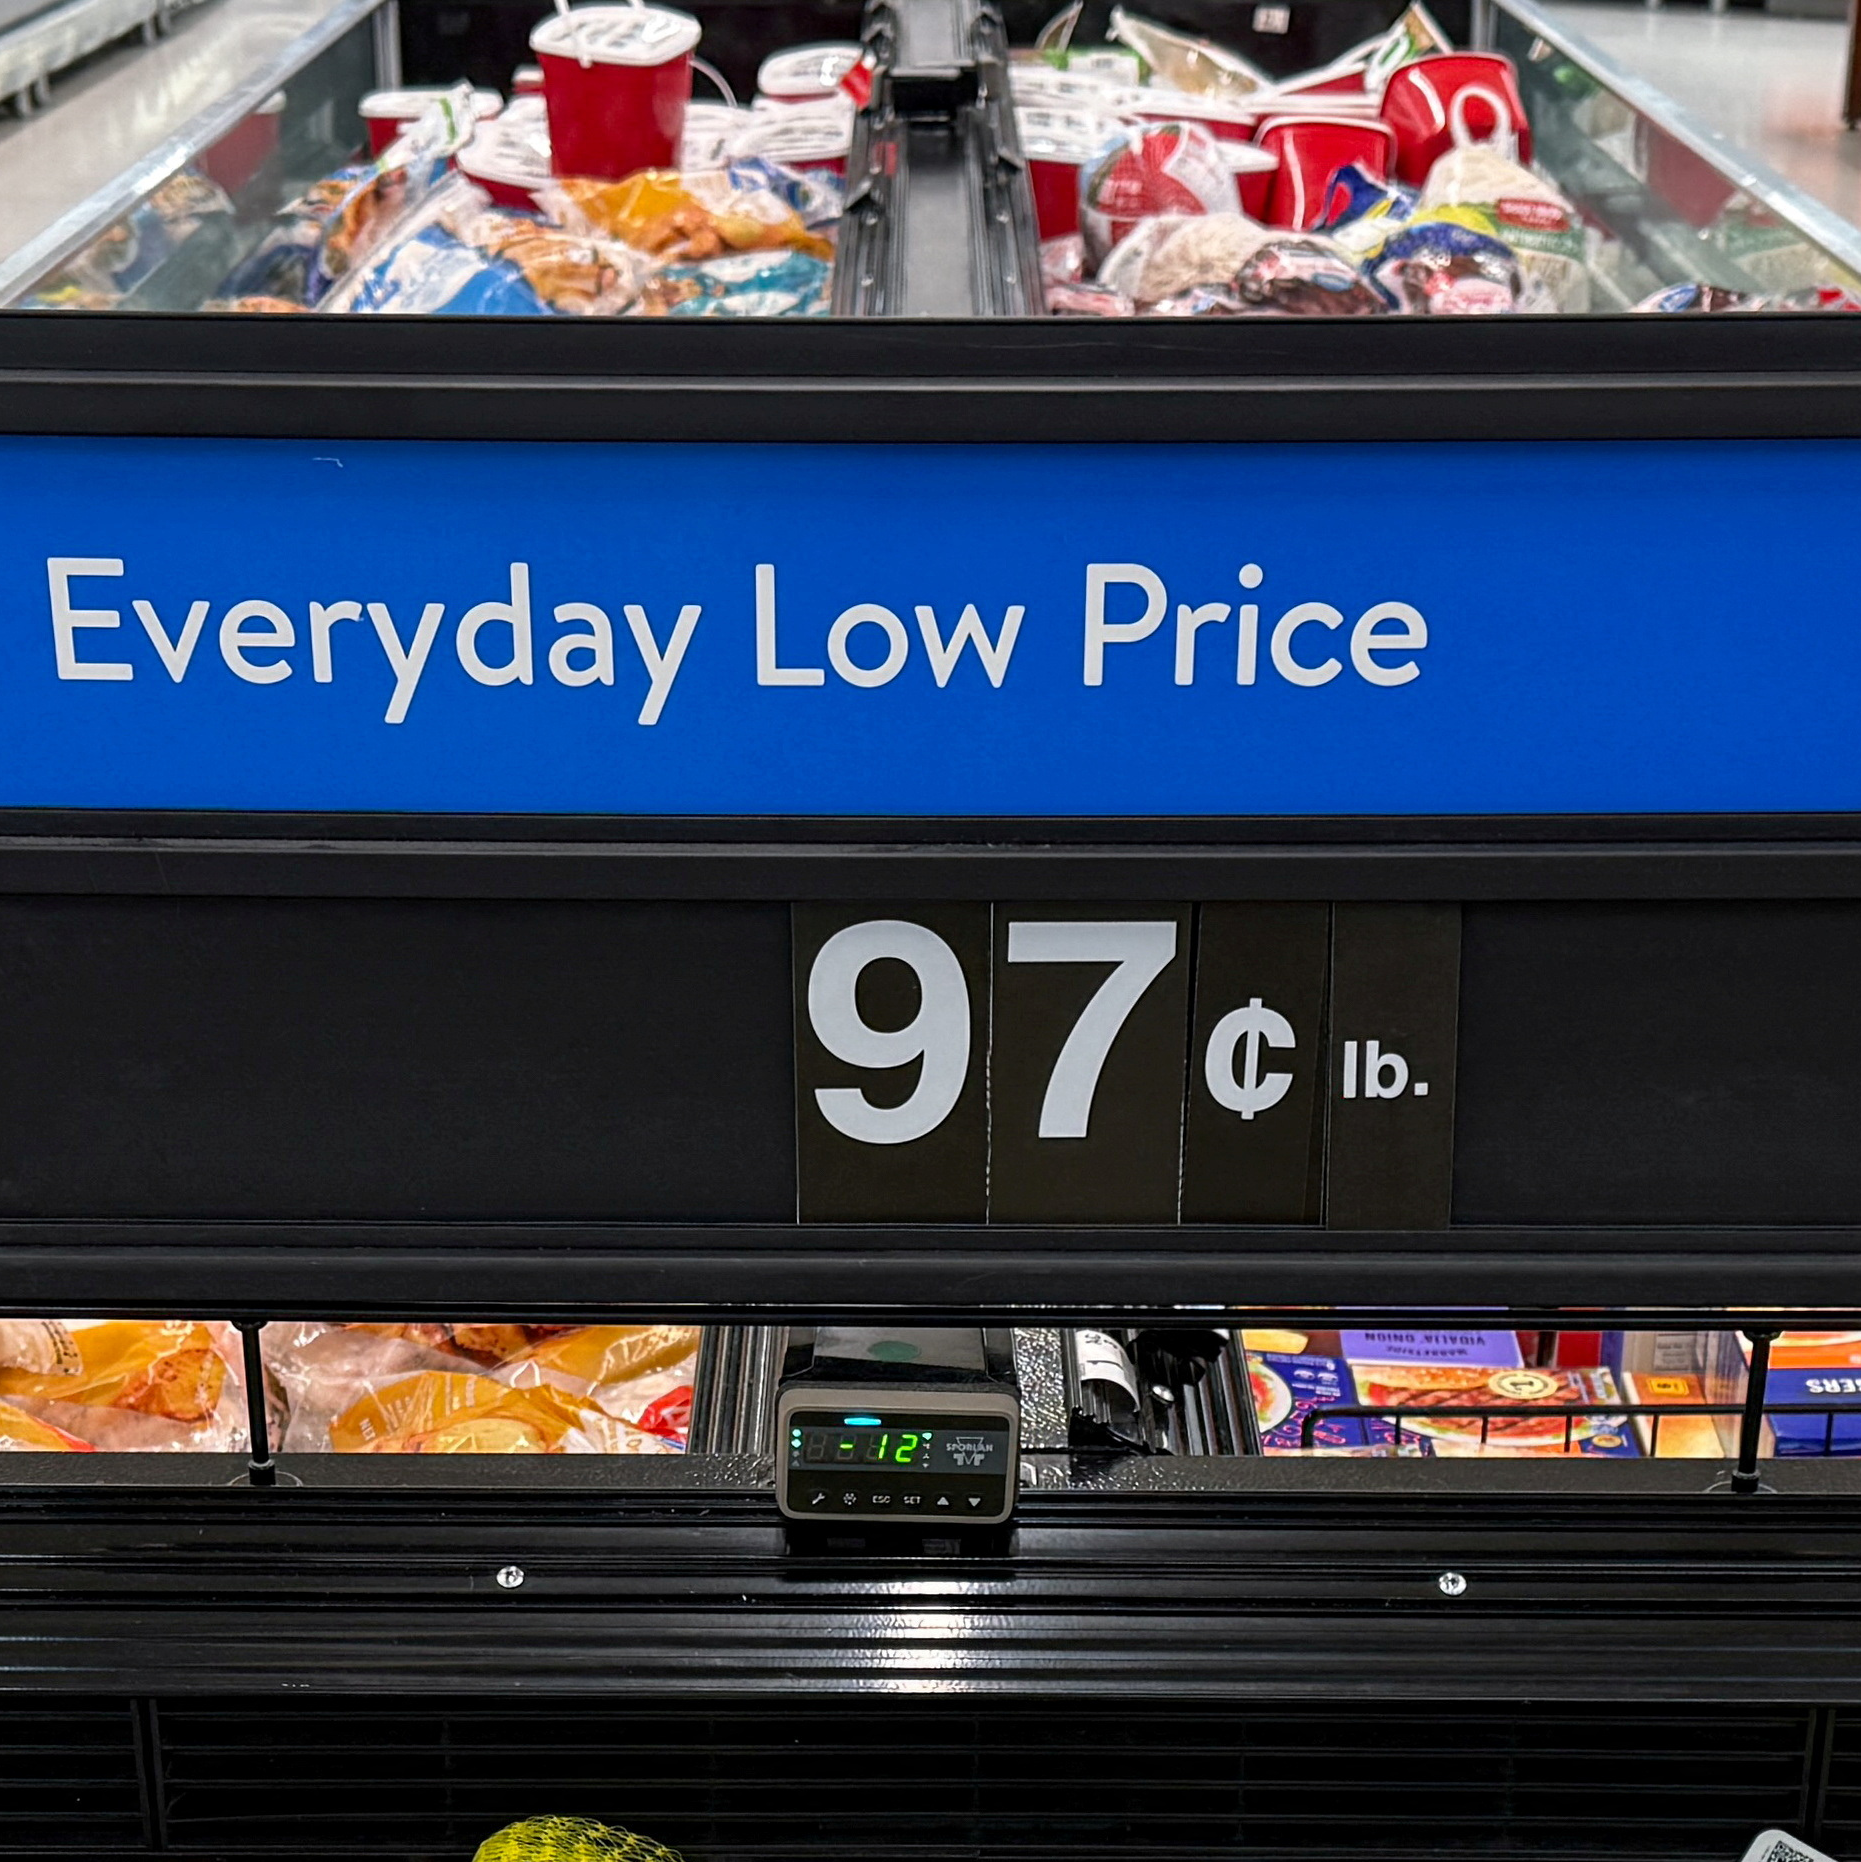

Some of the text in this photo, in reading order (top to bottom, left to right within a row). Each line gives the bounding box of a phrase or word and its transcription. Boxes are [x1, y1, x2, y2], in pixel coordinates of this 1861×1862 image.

[46, 556, 1430, 725] Everyday Low Price
[1342, 1040, 1430, 1103] lb.
[872, 1495, 921, 1504] ESC SET
